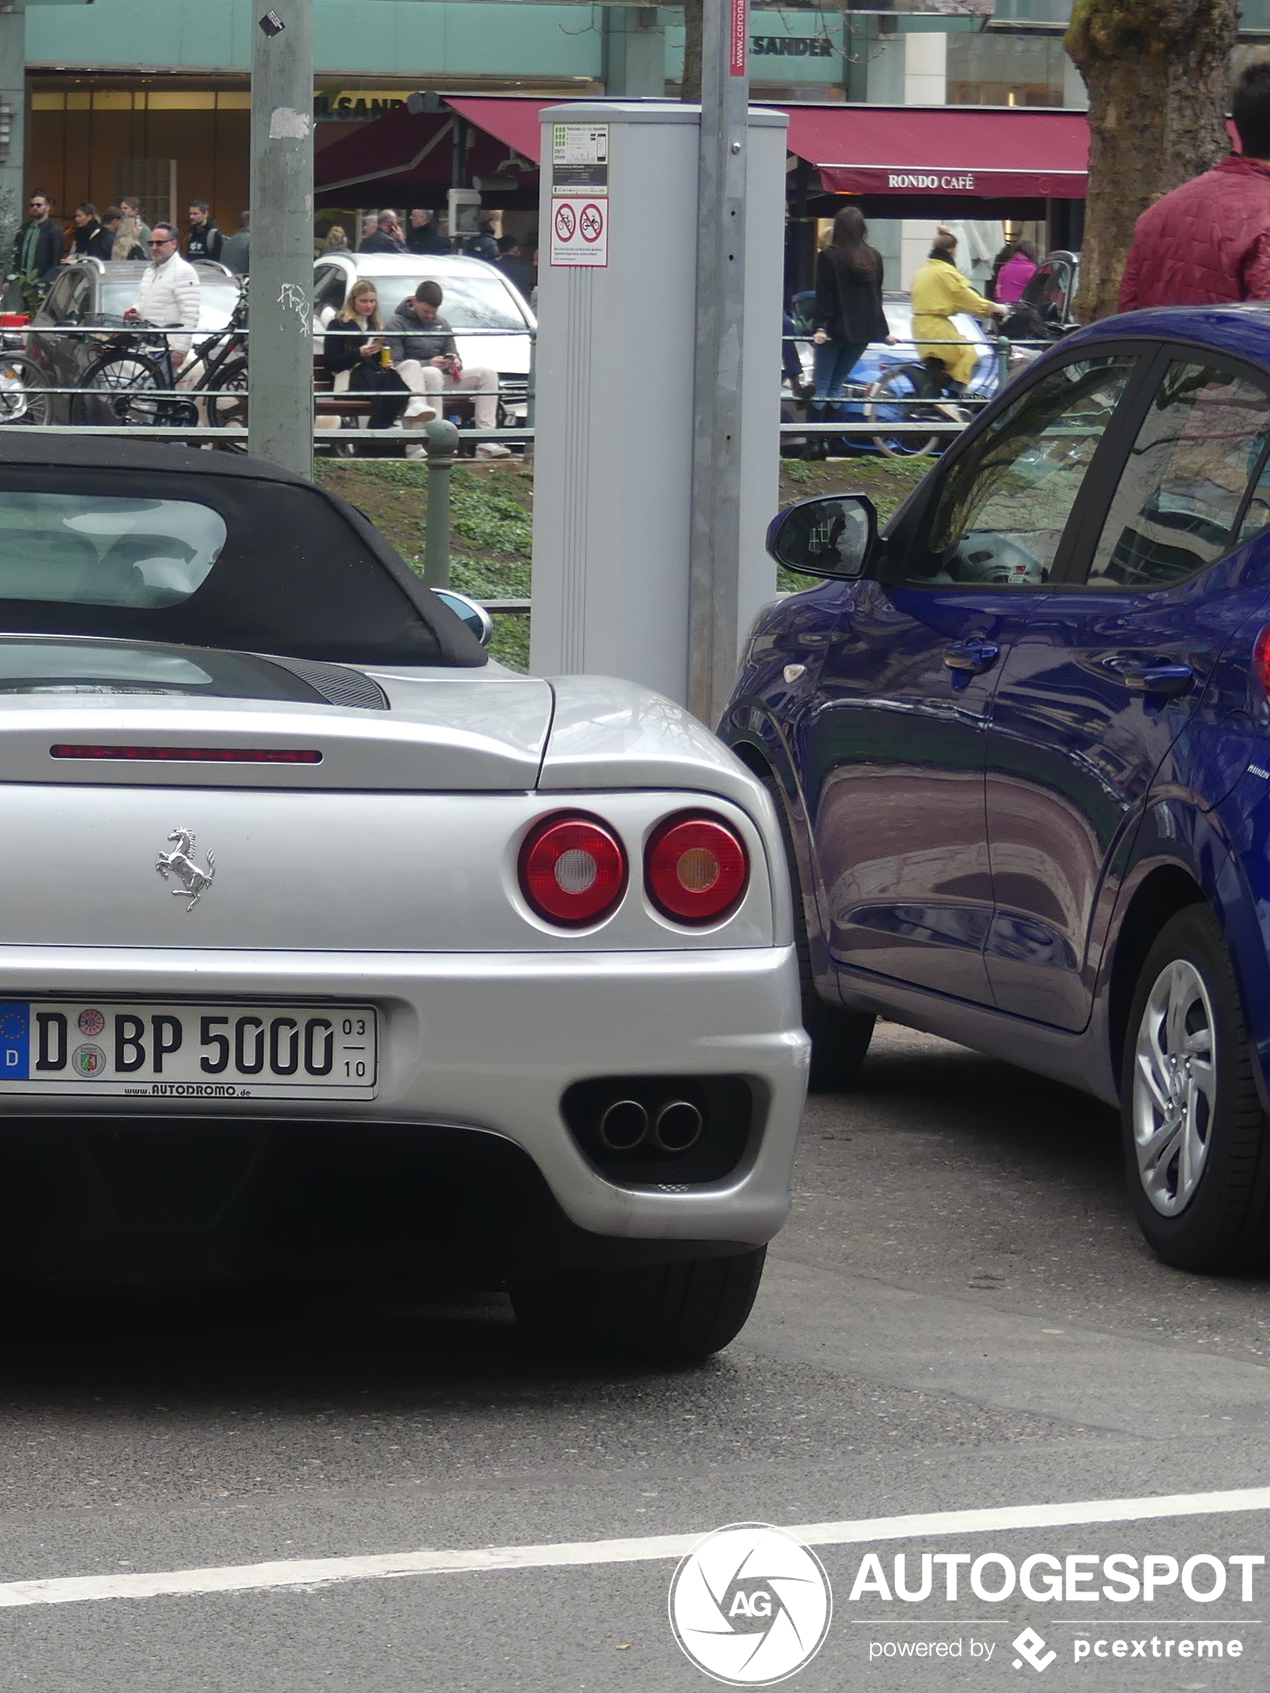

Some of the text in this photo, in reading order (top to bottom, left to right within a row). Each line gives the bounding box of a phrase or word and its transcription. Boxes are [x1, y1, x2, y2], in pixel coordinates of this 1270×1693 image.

[753, 37, 832, 57] SANDER
[888, 173, 975, 190] RONDO CAFÉ
[342, 1018, 366, 1036] 03
[6, 1049, 18, 1066] D
[35, 1012, 68, 1071] D
[114, 1014, 183, 1074] BP
[199, 1016, 335, 1076] 5000
[343, 1060, 366, 1078] 10
[124, 1084, 251, 1097] www.AUTODROMO.de
